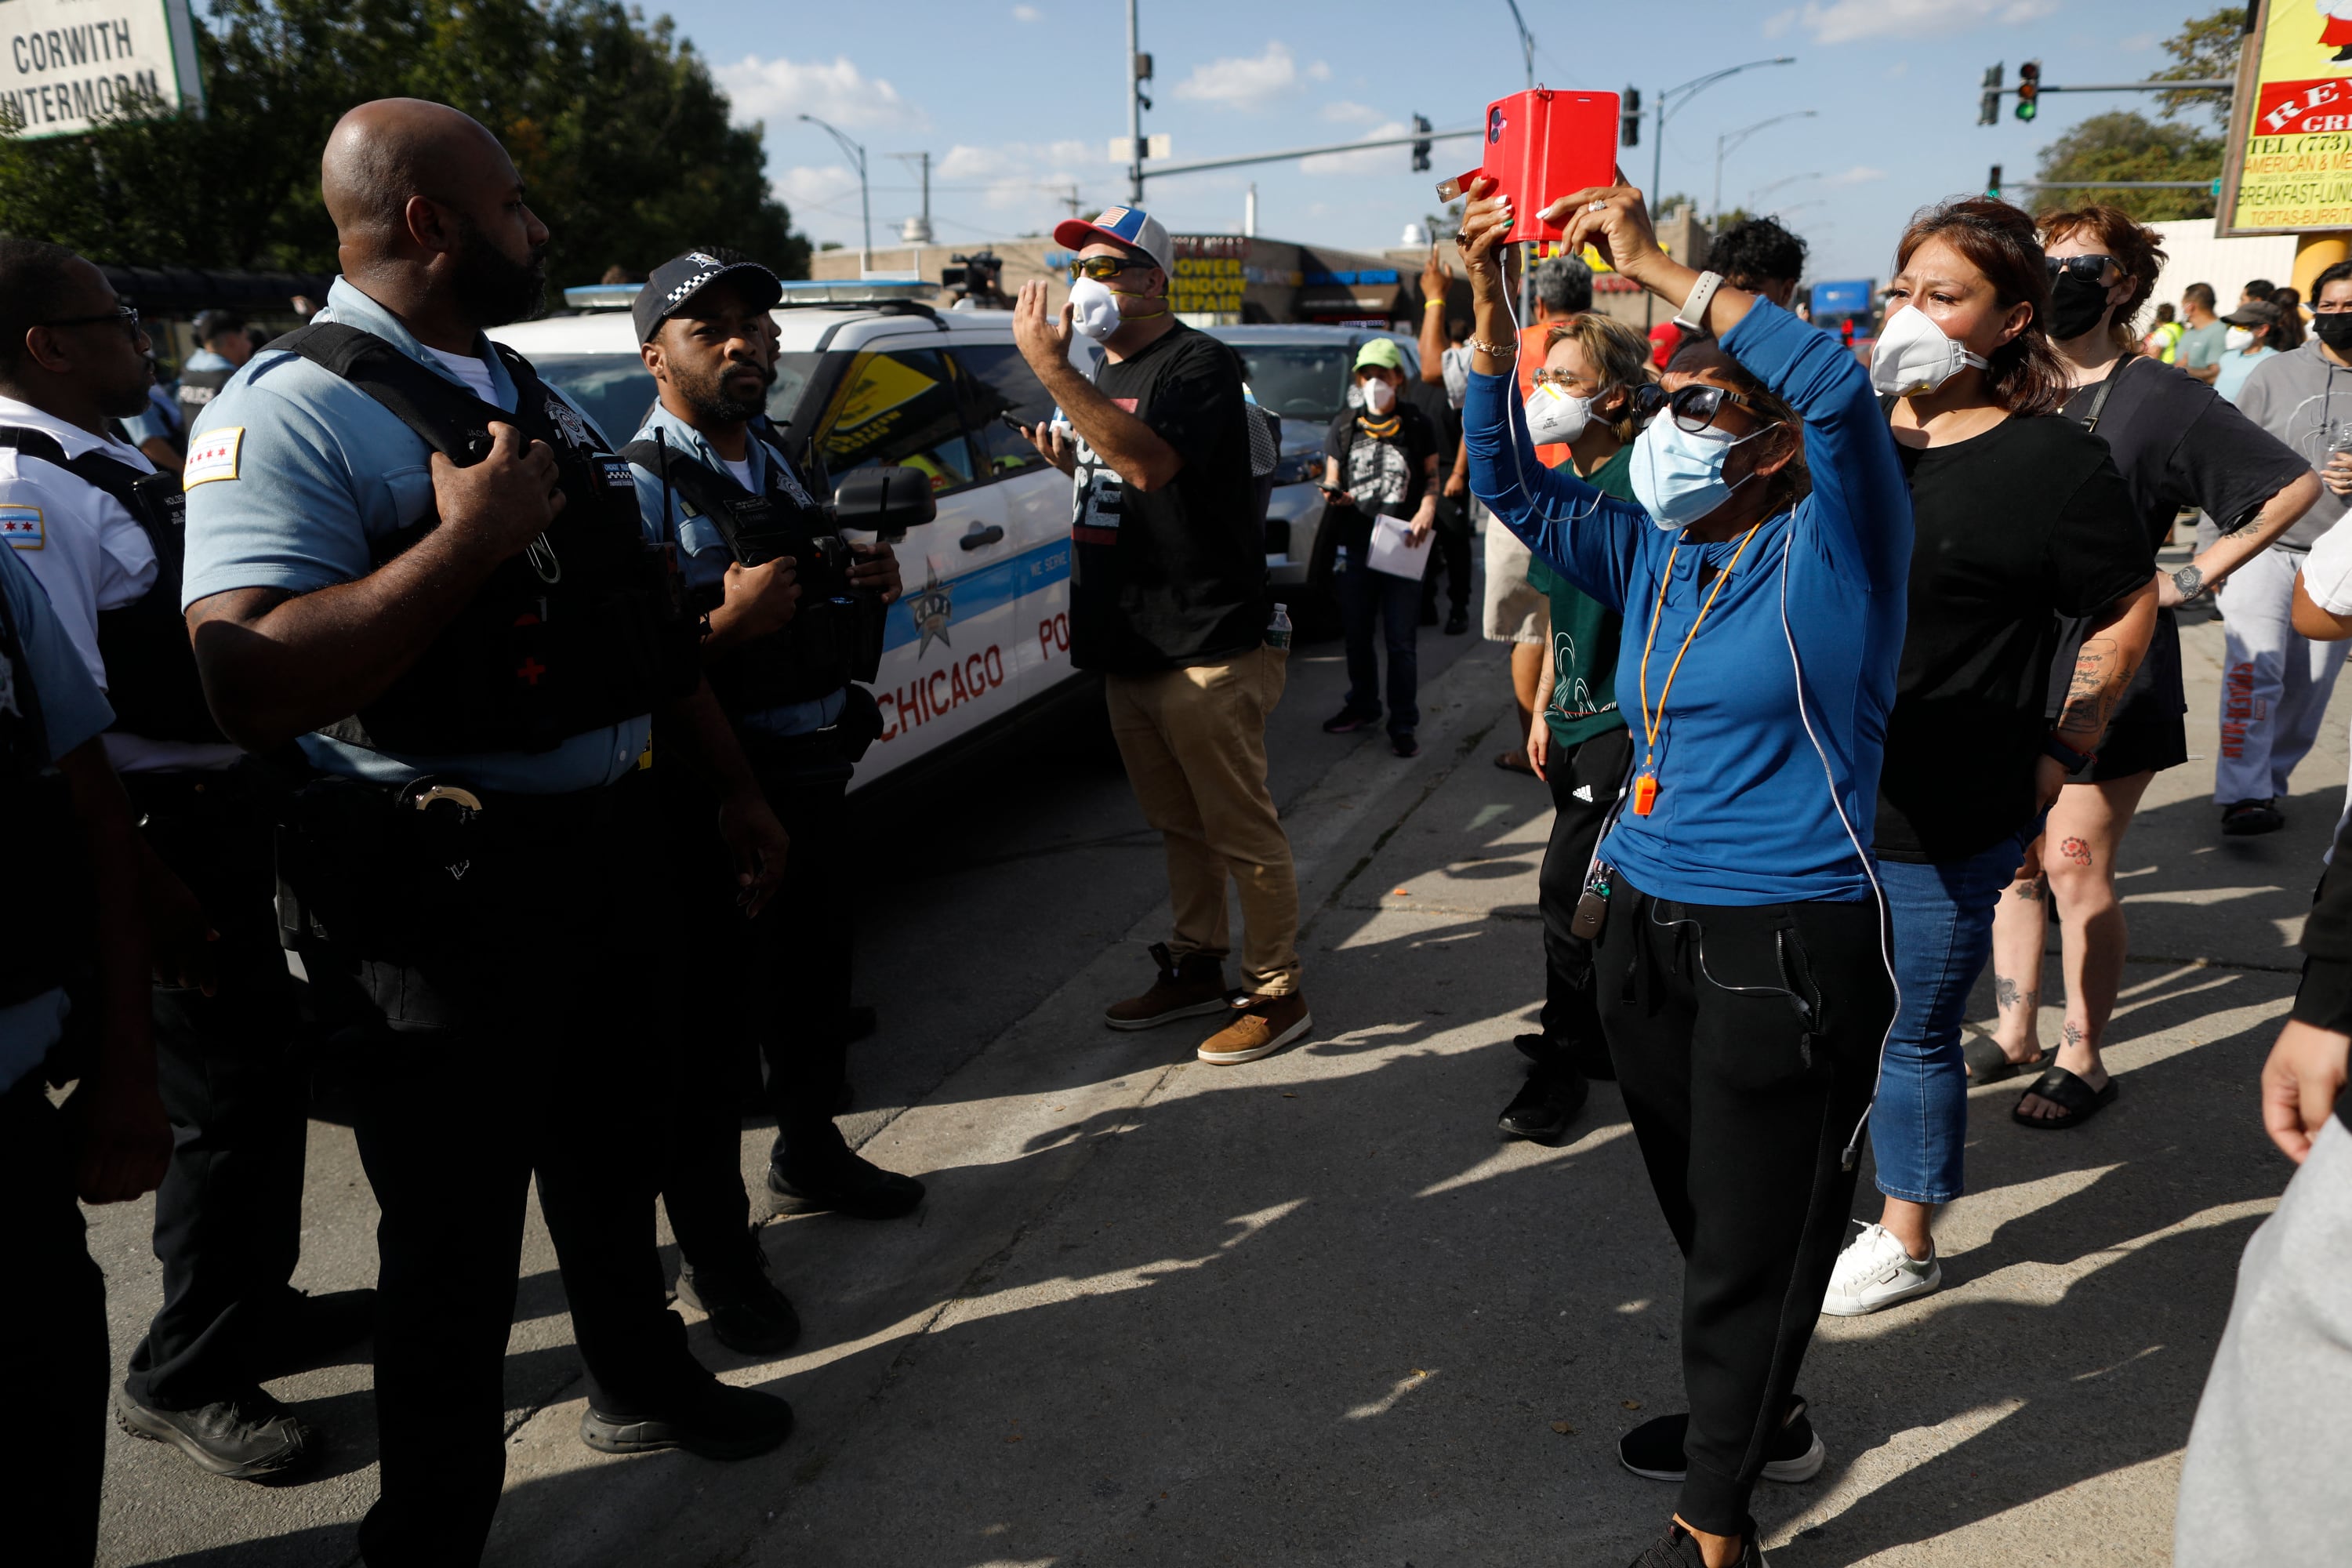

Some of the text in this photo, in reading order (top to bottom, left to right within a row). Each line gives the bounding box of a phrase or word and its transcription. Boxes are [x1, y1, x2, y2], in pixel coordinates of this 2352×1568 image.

[13, 18, 132, 74] CORWITH
[2248, 137, 2289, 154] TEL
[2244, 155, 2316, 174] AMERICAN
[2320, 154, 2328, 170] &
[1030, 551, 1067, 578] WE SERVE
[916, 597, 948, 624] CAPS
[876, 613, 1070, 742] CHICAGO PO
[2221, 662, 2254, 758] SPIDER-MAN
[1572, 789, 1593, 803] adidas
